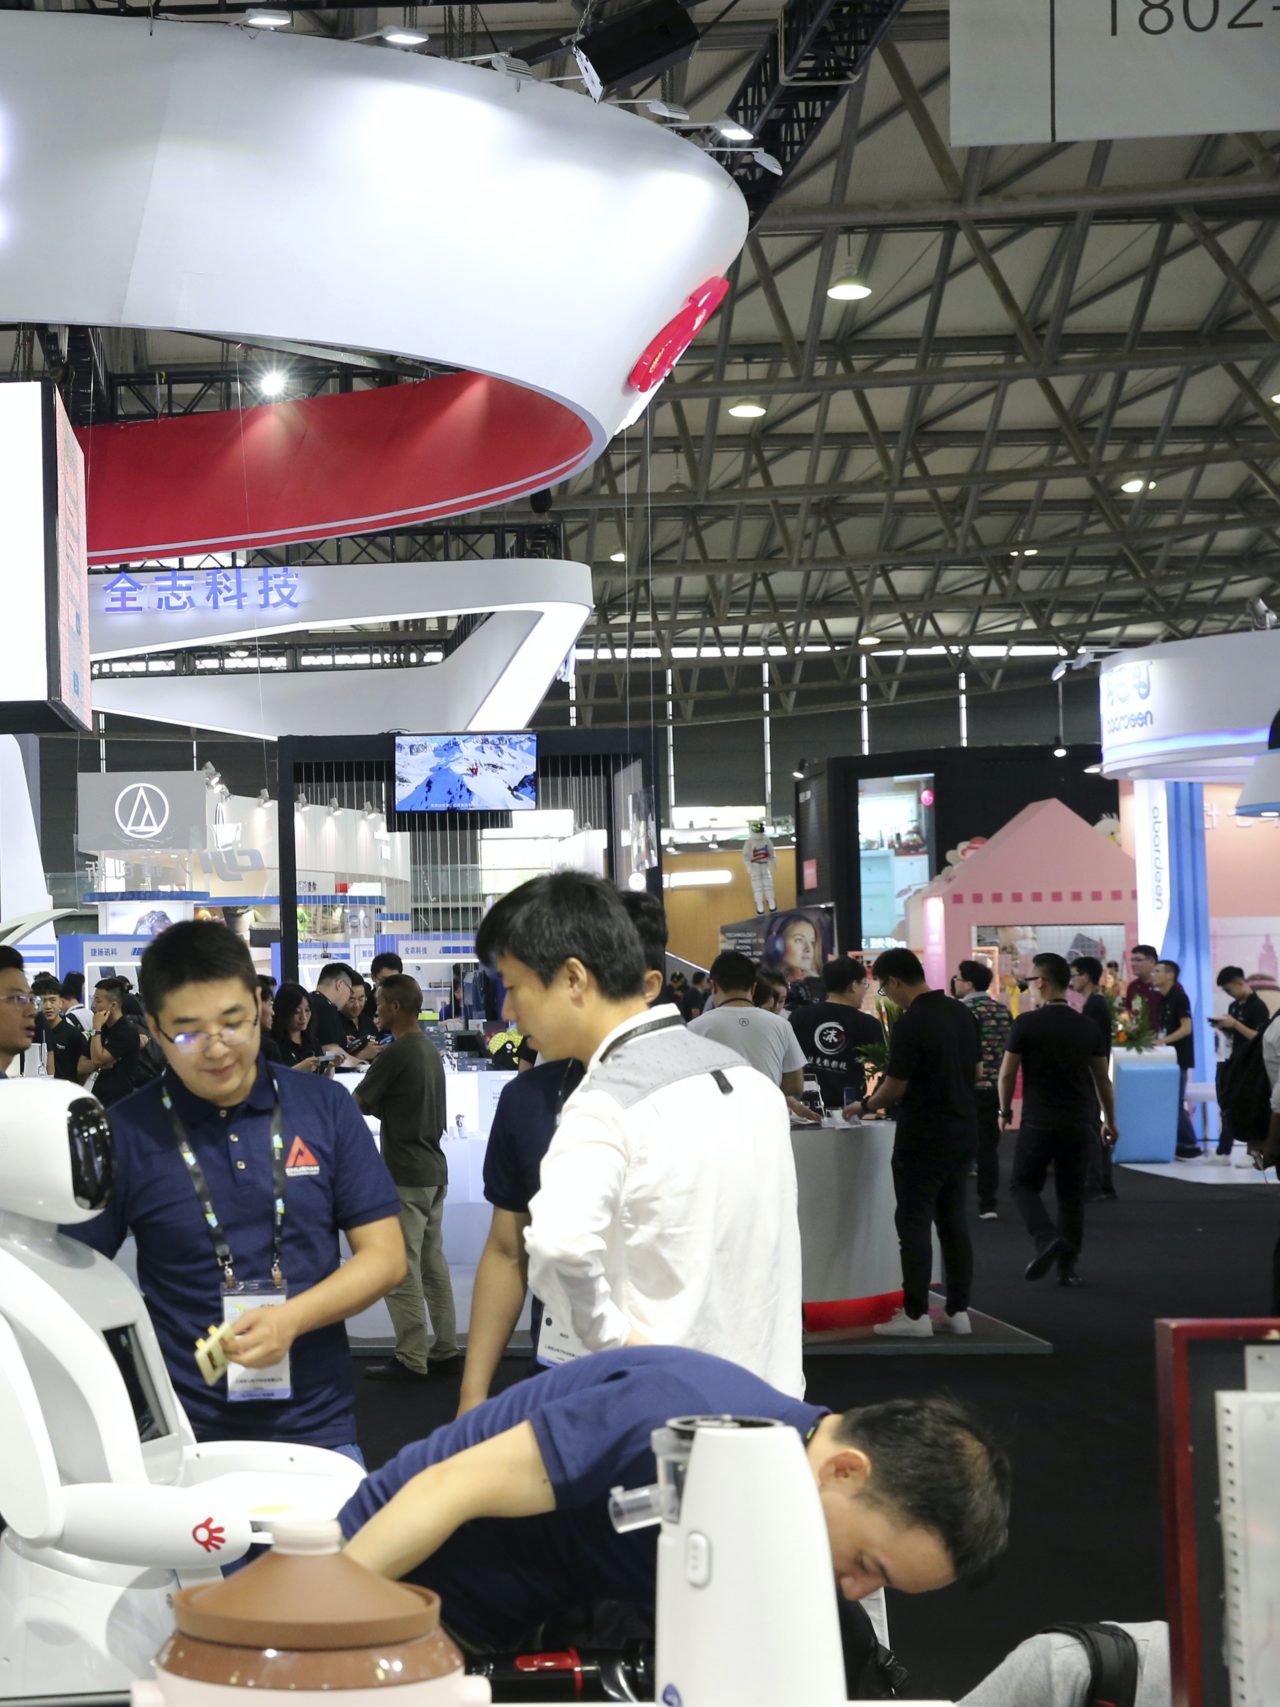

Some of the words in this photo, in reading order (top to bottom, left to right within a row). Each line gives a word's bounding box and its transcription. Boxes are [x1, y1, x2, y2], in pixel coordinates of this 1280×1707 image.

[102, 566, 301, 614] 全志科技
[1151, 805, 1164, 911] abardeen
